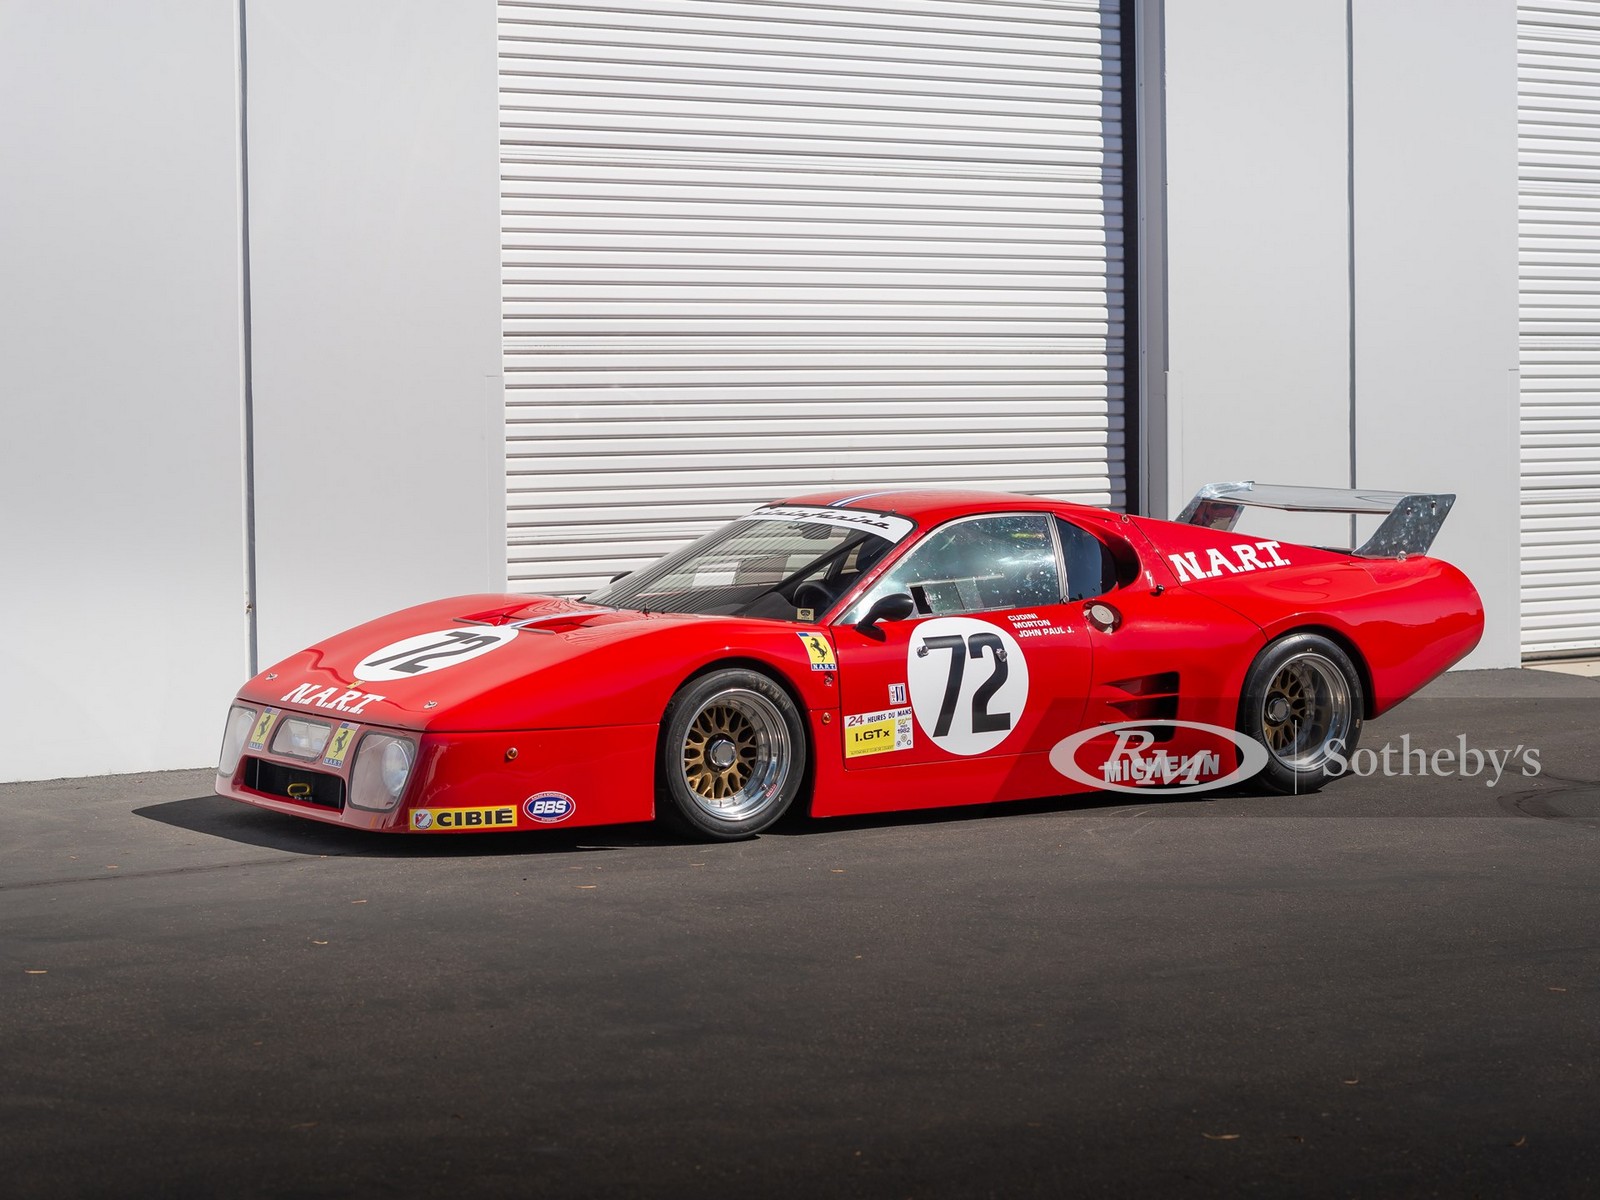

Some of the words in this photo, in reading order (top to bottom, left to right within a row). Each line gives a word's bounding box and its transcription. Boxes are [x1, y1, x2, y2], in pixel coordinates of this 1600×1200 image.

[1168, 540, 1292, 582] N.A.R.T.
[1007, 613, 1038, 621] CUDINI
[1013, 619, 1051, 628] MORTON
[1018, 629, 1042, 638] JOHN
[1042, 627, 1066, 635] PAUL
[365, 631, 502, 674] 72
[922, 633, 1011, 737] 72
[847, 715, 865, 727] 24
[867, 714, 887, 724] HEURES
[888, 711, 896, 719] DU
[897, 708, 912, 717] MANS
[855, 728, 890, 741] I.GTx
[1103, 754, 1220, 783] MICHELIN
[532, 800, 567, 814] BBS
